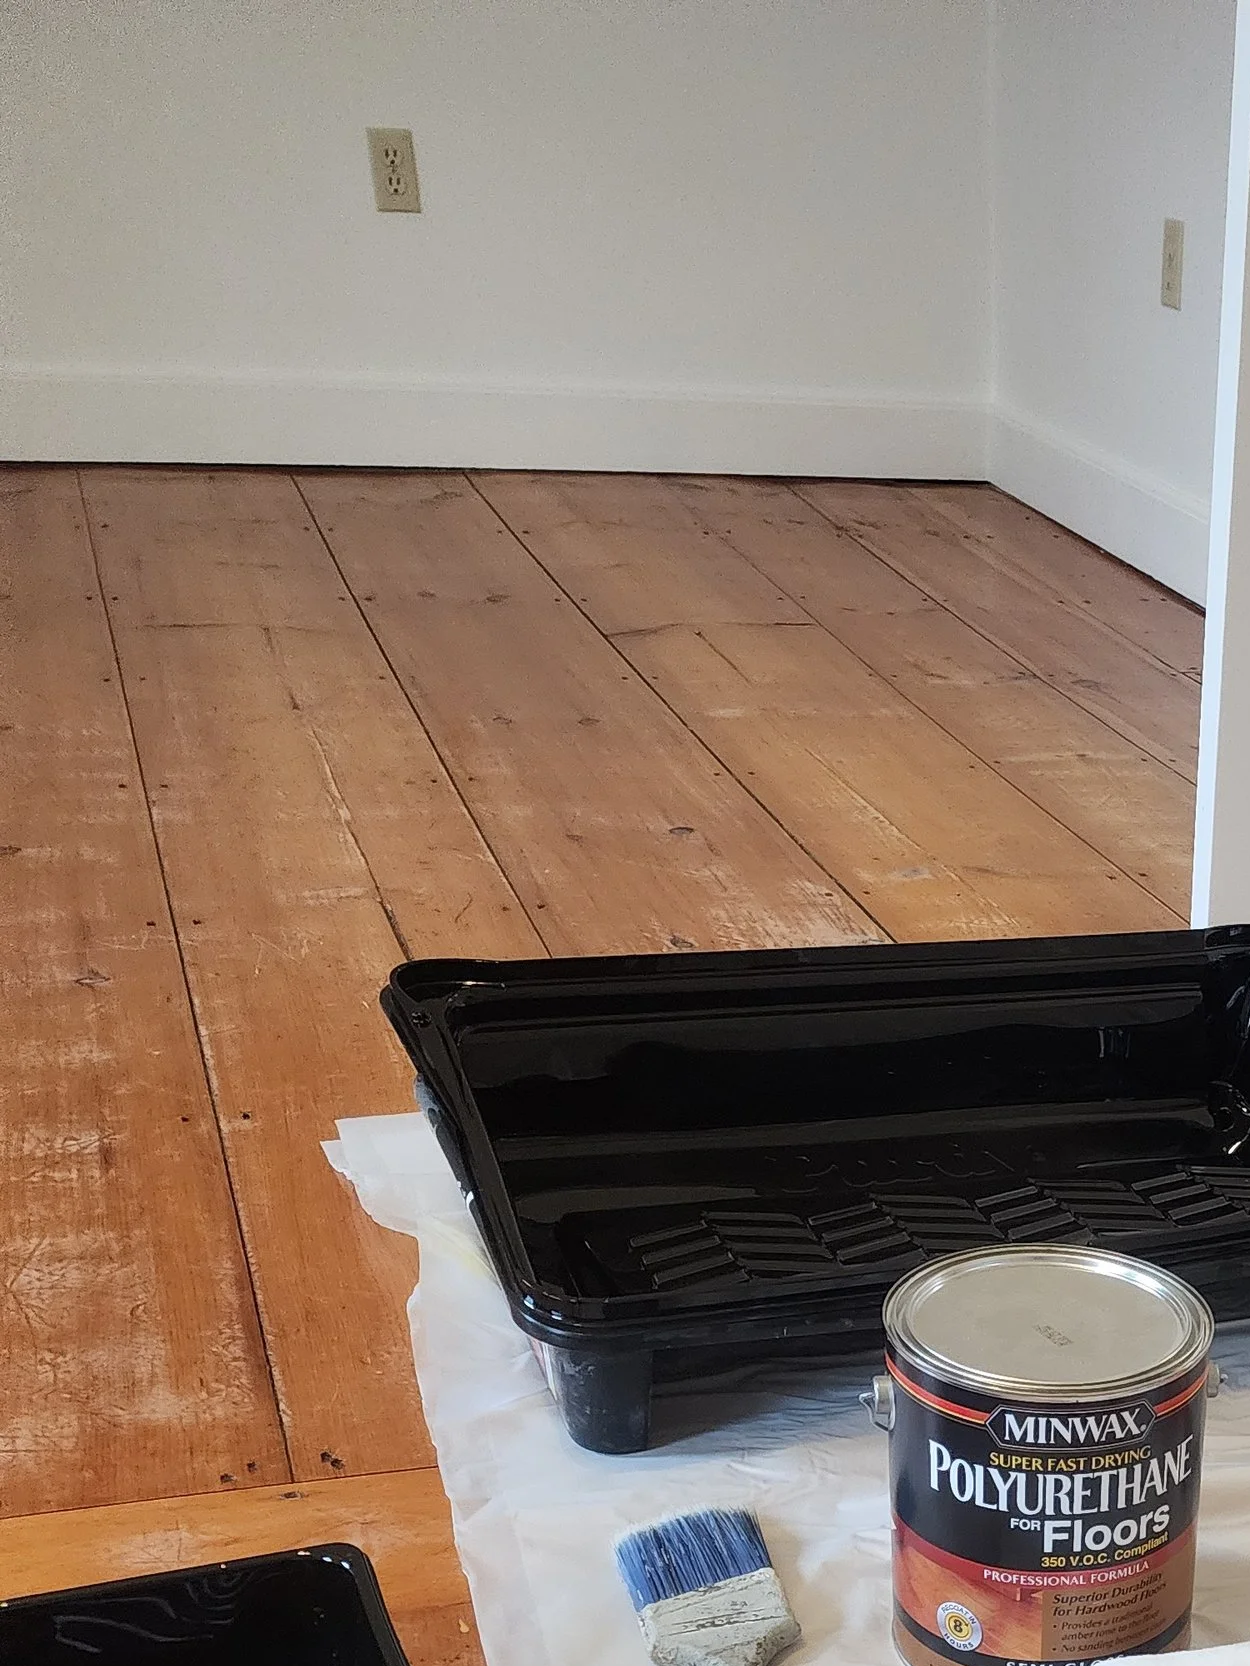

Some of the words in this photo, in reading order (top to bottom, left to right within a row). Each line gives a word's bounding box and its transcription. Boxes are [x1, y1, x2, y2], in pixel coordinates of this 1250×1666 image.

[1004, 1408, 1143, 1444] MINWAX
[989, 1452, 1042, 1471] SUPER
[1047, 1457, 1085, 1472] FAST
[1091, 1445, 1151, 1469] DRYING
[929, 1434, 1194, 1515] POLYURETHANE
[1010, 1517, 1041, 1531] FOR
[1043, 1504, 1170, 1553] Floors
[1041, 1556, 1065, 1568] 350
[1070, 1553, 1110, 1567] V.O.C.
[1114, 1531, 1169, 1562] Compliant
[983, 1569, 1086, 1587] PROFESSIONAL
[1090, 1561, 1149, 1584] FORMULA
[1053, 1590, 1109, 1606] Superior
[1053, 1605, 1073, 1617] for
[1075, 1595, 1138, 1617] Hardwood
[954, 1619, 963, 1633] 8
[1061, 1619, 1102, 1630] Provides
[1061, 1630, 1094, 1641] amber
[944, 1633, 974, 1649] HOURS
